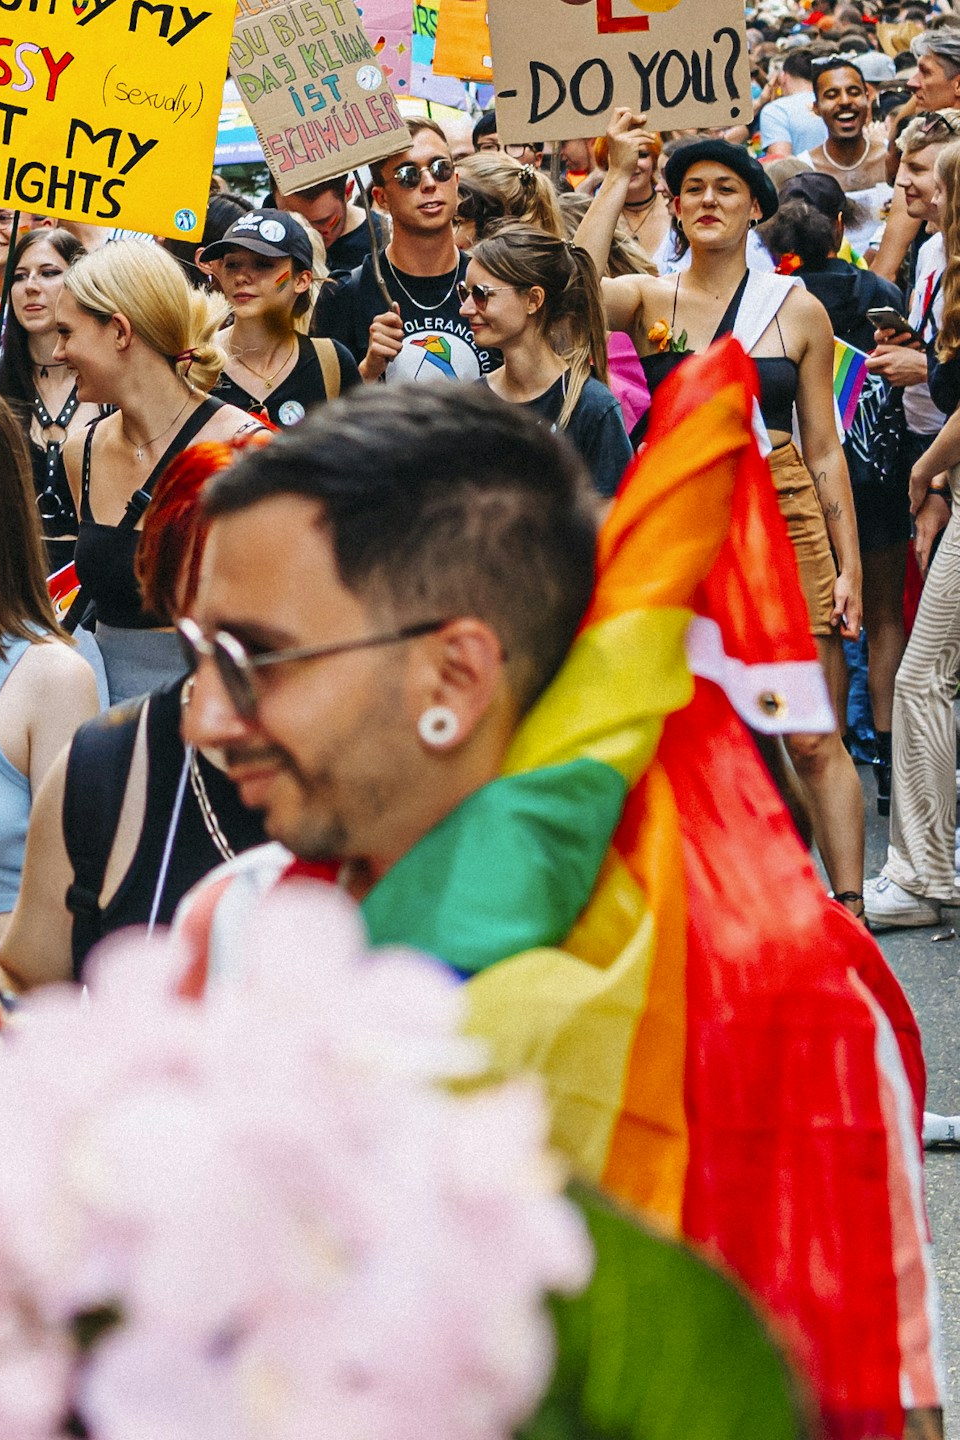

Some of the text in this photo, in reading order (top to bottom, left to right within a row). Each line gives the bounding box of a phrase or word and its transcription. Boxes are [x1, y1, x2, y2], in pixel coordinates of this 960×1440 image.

[230, 26, 270, 69] DU
[237, 54, 297, 104] DAS
[628, 27, 742, 119] YOU?
